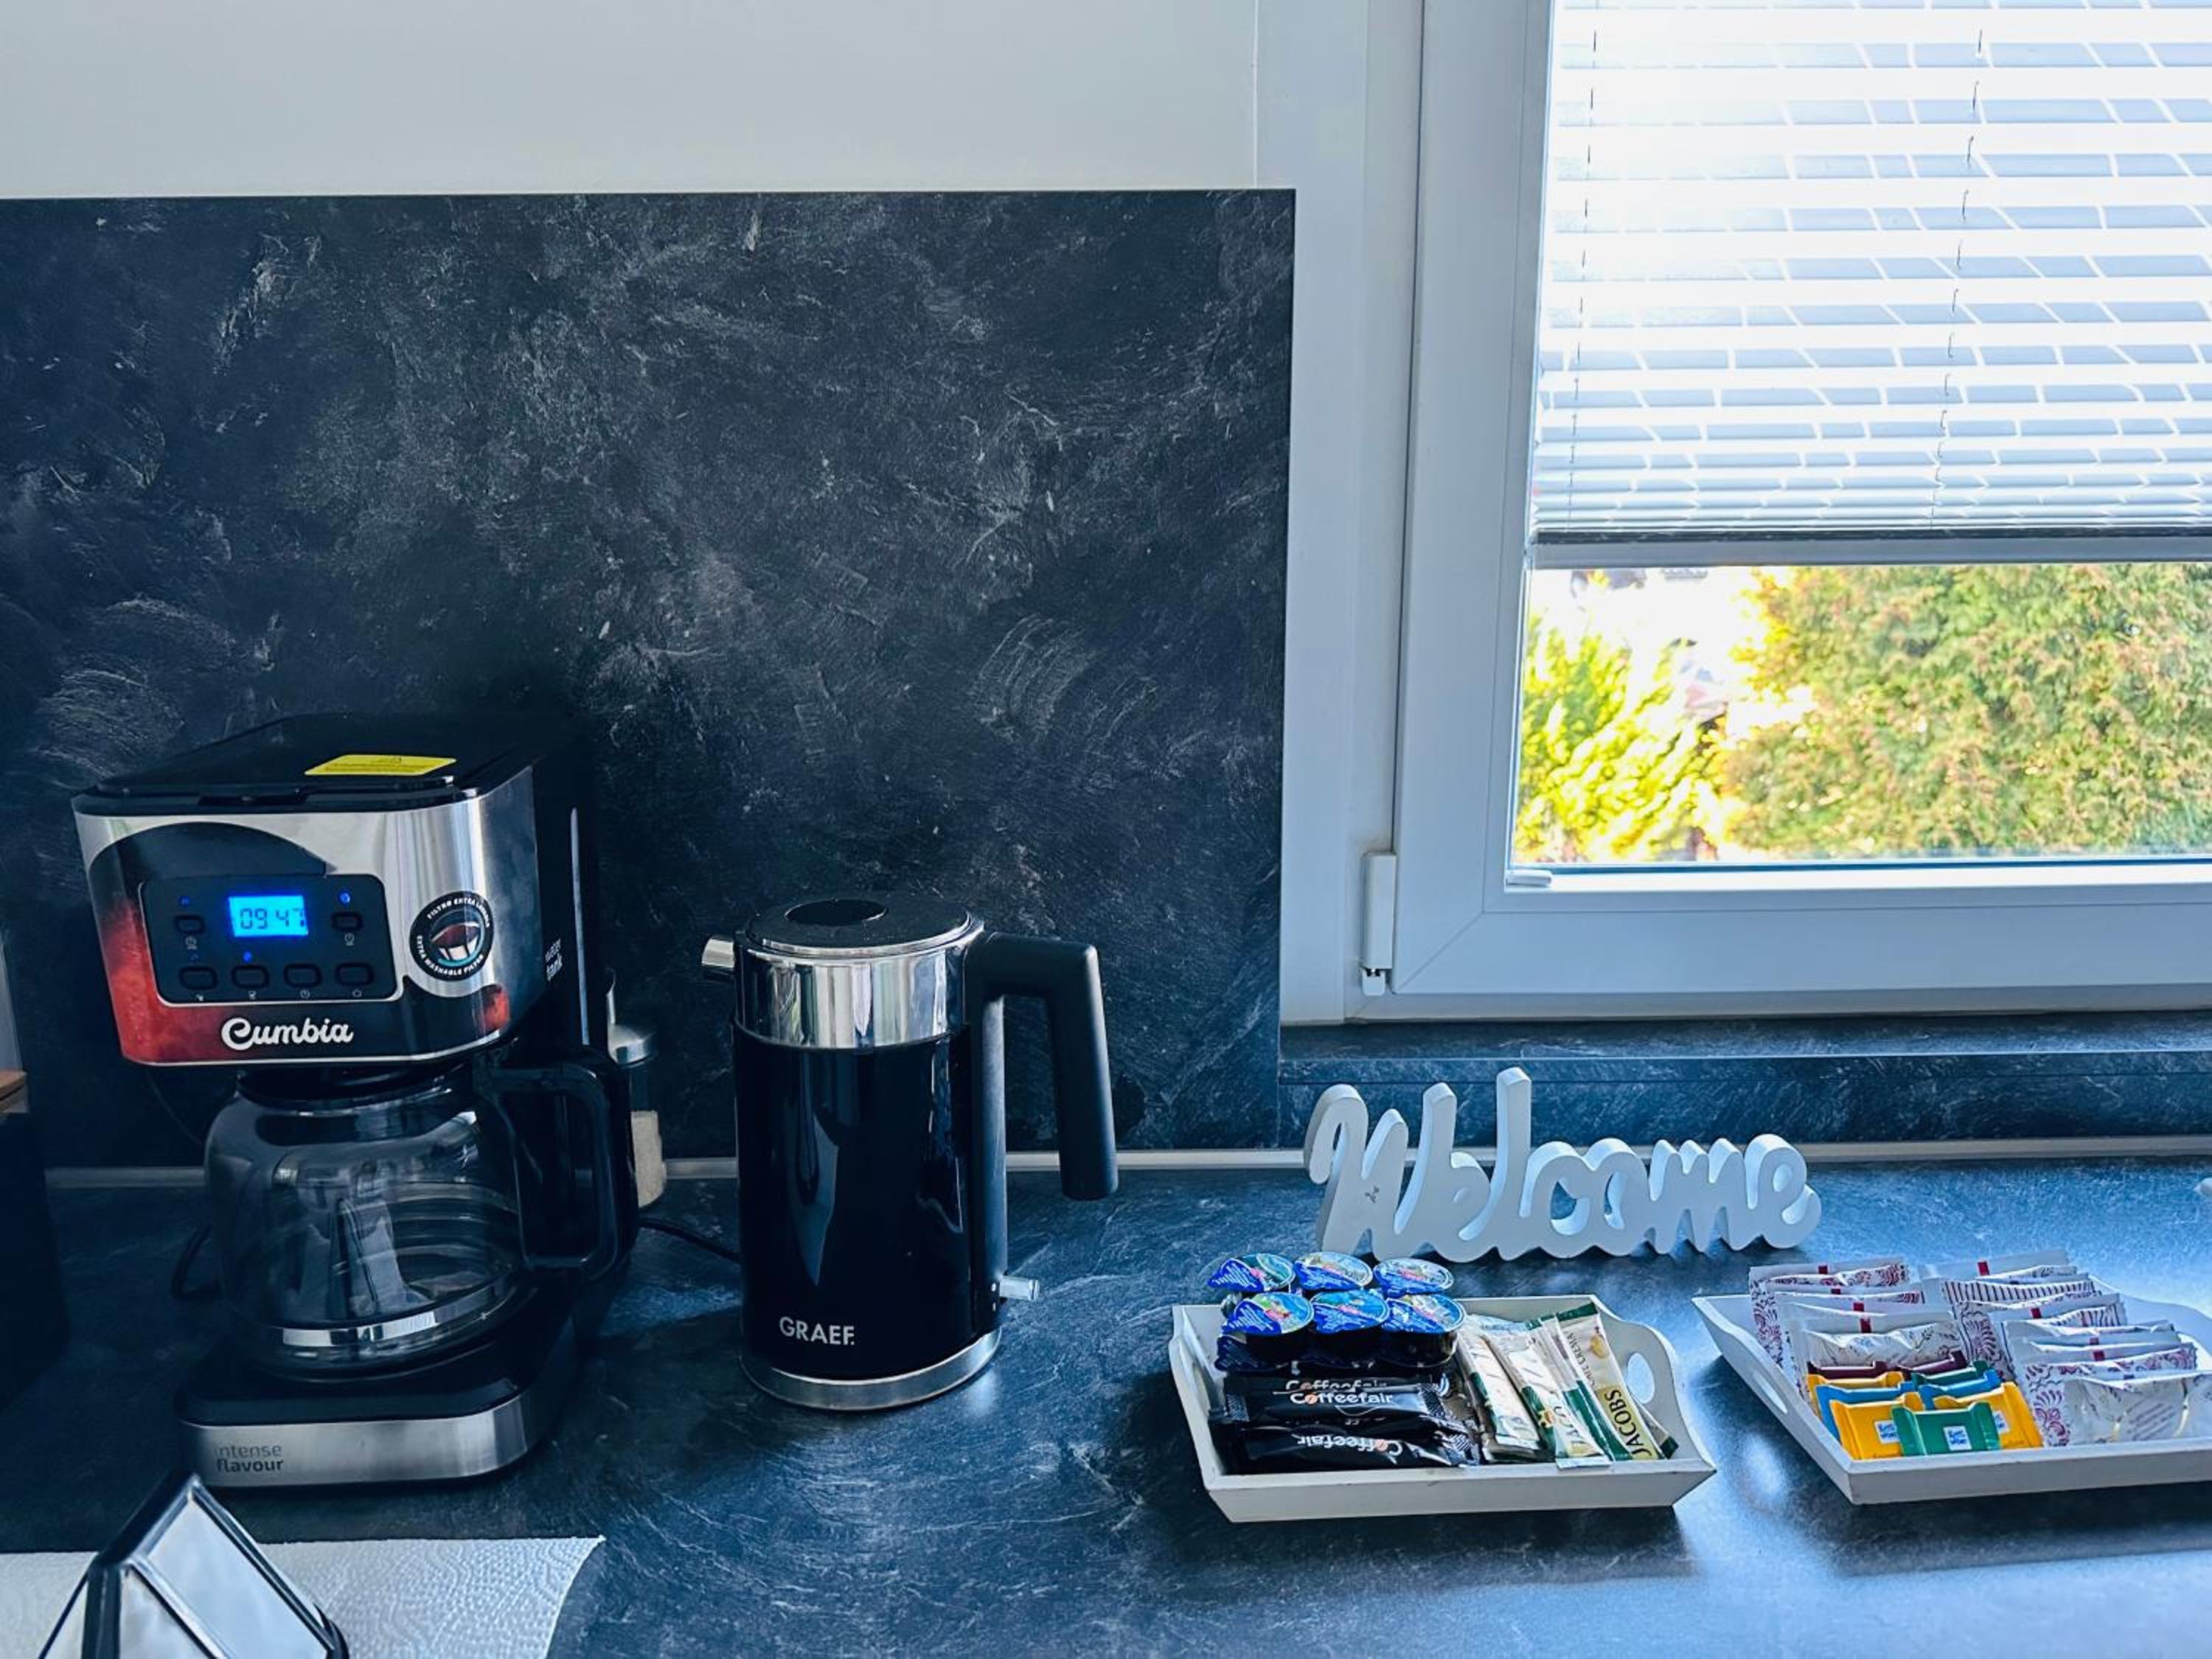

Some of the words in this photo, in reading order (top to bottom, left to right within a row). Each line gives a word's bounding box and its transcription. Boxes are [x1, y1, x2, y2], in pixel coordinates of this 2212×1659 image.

[221, 1018, 354, 1051] Cumbia
[1303, 1067, 1821, 1263] Welcome
[1290, 1392, 1394, 1405] Coffeefair
[1604, 1389, 1652, 1456] JACOBS
[215, 1444, 282, 1458] intense
[1297, 1434, 1402, 1457] Coffeefair
[216, 1458, 284, 1472] flavour
